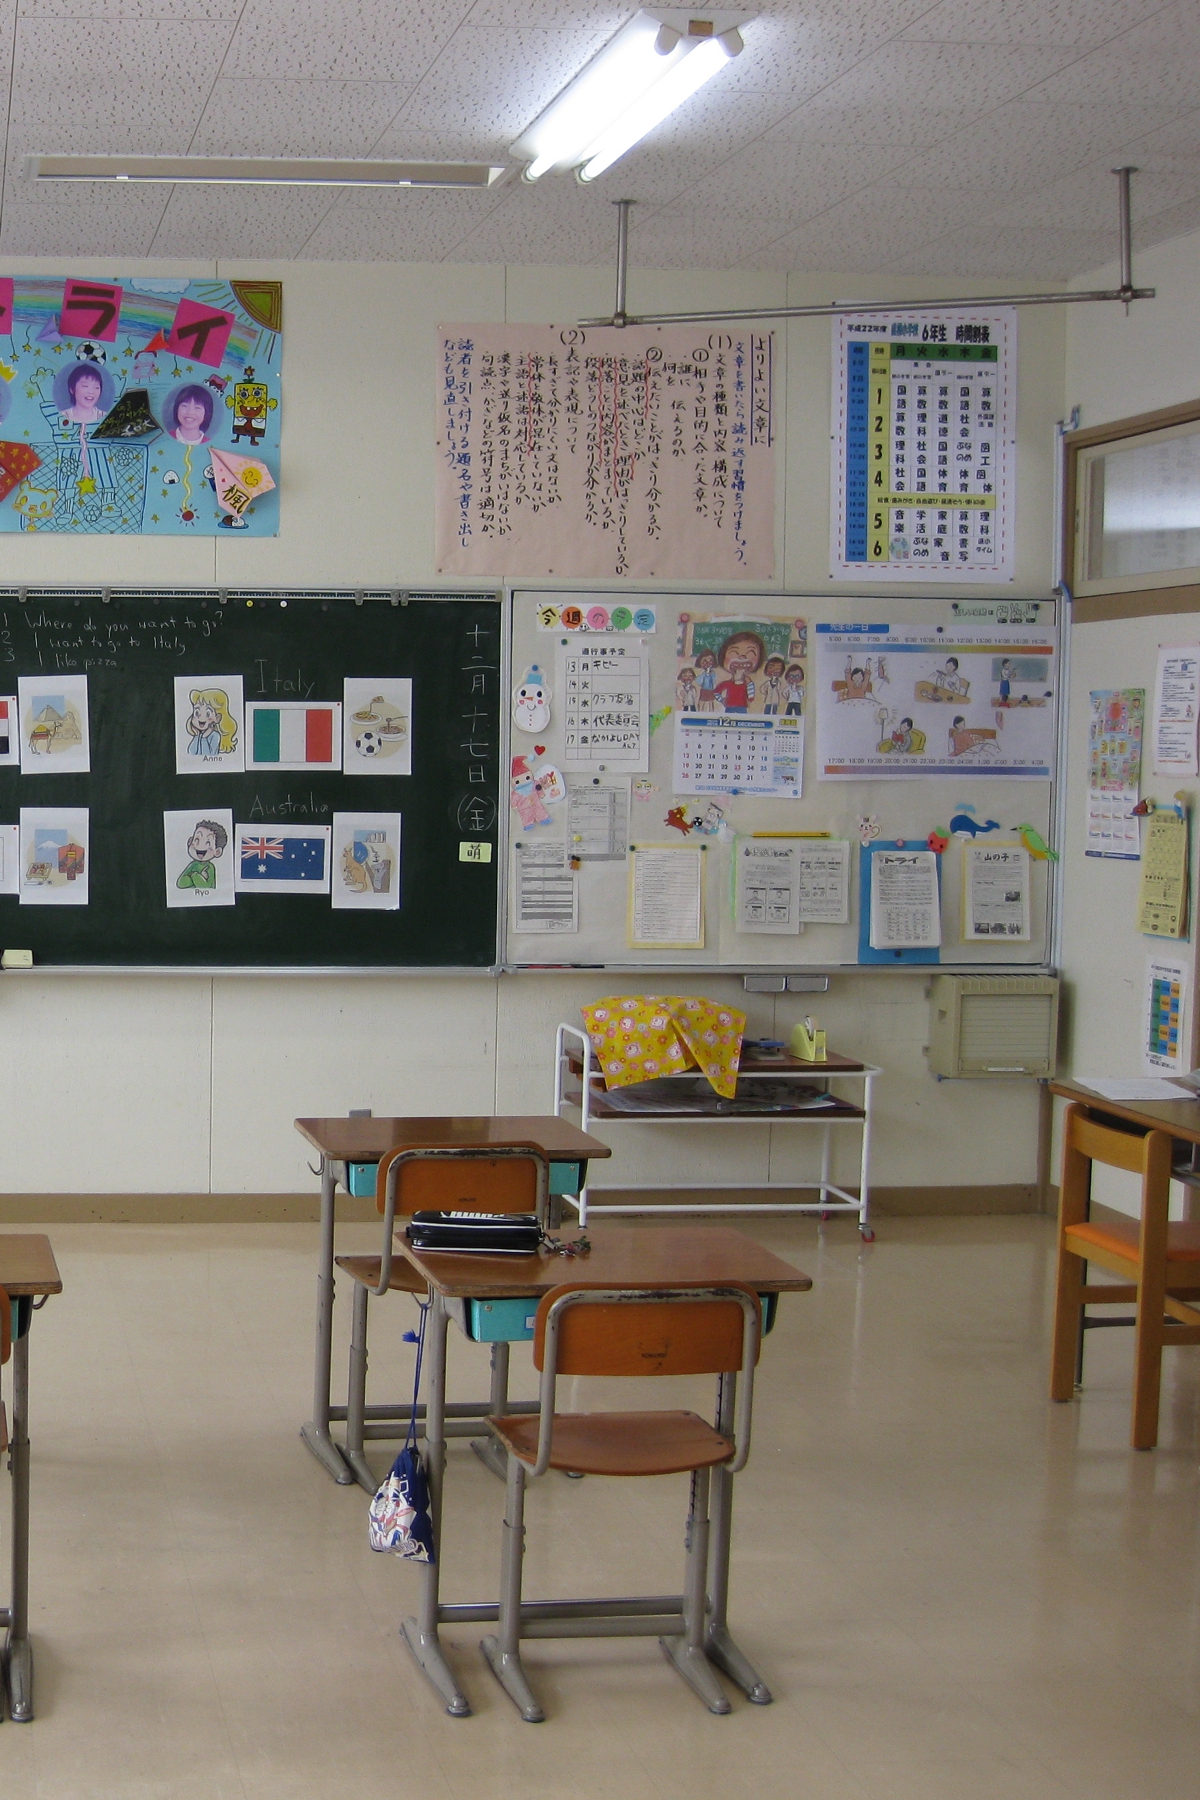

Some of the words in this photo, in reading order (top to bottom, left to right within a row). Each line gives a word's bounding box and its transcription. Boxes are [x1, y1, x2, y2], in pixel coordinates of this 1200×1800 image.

[847, 324, 887, 333] 平成22年度
[922, 324, 947, 342] 6年生
[956, 325, 990, 343] 時間割表
[896, 346, 905, 356] 月
[917, 346, 927, 356] 火
[938, 347, 949, 357] 水
[960, 347, 970, 357] 木
[981, 348, 991, 358] 金
[753, 337, 769, 444] よりよい文章に
[877, 387, 882, 405] 1
[874, 416, 883, 432] 2
[875, 444, 883, 460] 3
[874, 471, 883, 487] 4
[874, 513, 882, 529] 5
[873, 541, 882, 556] 6
[25, 610, 72, 630] Where
[84, 617, 97, 632] do
[105, 622, 129, 638] you
[138, 617, 176, 630] want
[184, 617, 197, 629] to
[1, 630, 12, 644] 2
[50, 637, 84, 648] want
[91, 637, 102, 648] to
[107, 640, 121, 653] go
[129, 637, 141, 647] to
[4, 648, 16, 662] 3
[56, 653, 77, 668] like
[83, 657, 117, 670] pizza
[568, 661, 576, 672] 13
[582, 663, 589, 671] 月
[254, 659, 316, 699] Italy
[568, 680, 576, 689] 14
[582, 681, 589, 689] 火
[581, 718, 589, 726] 木
[567, 734, 575, 744] 17
[581, 735, 589, 744] 金
[249, 791, 329, 818] Australia
[884, 856, 919, 864] トライ
[984, 853, 1010, 862] 山の子
